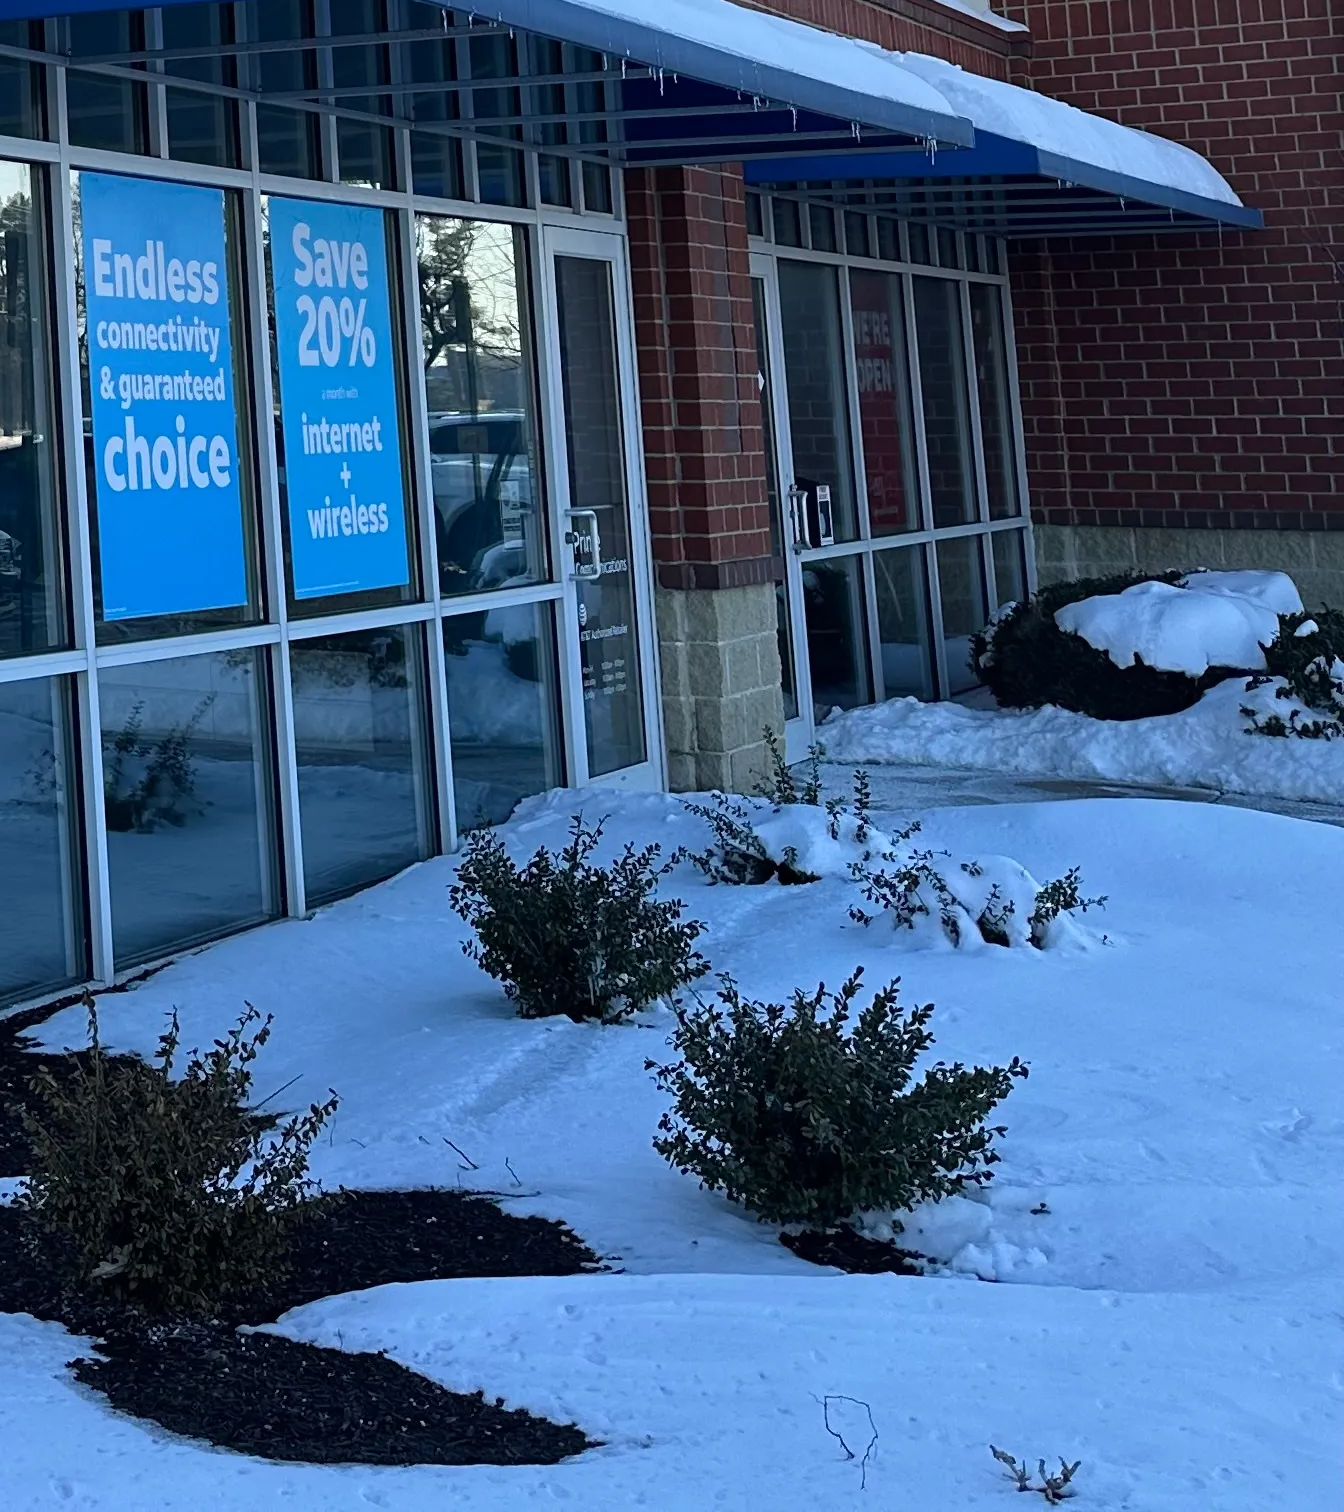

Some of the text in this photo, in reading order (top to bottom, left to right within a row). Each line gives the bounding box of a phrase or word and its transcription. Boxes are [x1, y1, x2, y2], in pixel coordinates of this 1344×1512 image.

[92, 238, 219, 305] Endless
[292, 222, 369, 291] Save
[96, 314, 220, 363] connectivity
[295, 294, 377, 368] 20%
[99, 365, 226, 410] & guaranteed
[857, 358, 892, 393] OPEN
[103, 414, 231, 492] choice
[301, 411, 383, 455] internet
[340, 461, 352, 489] +
[307, 494, 389, 540] wireless
[572, 530, 601, 555] Prim
